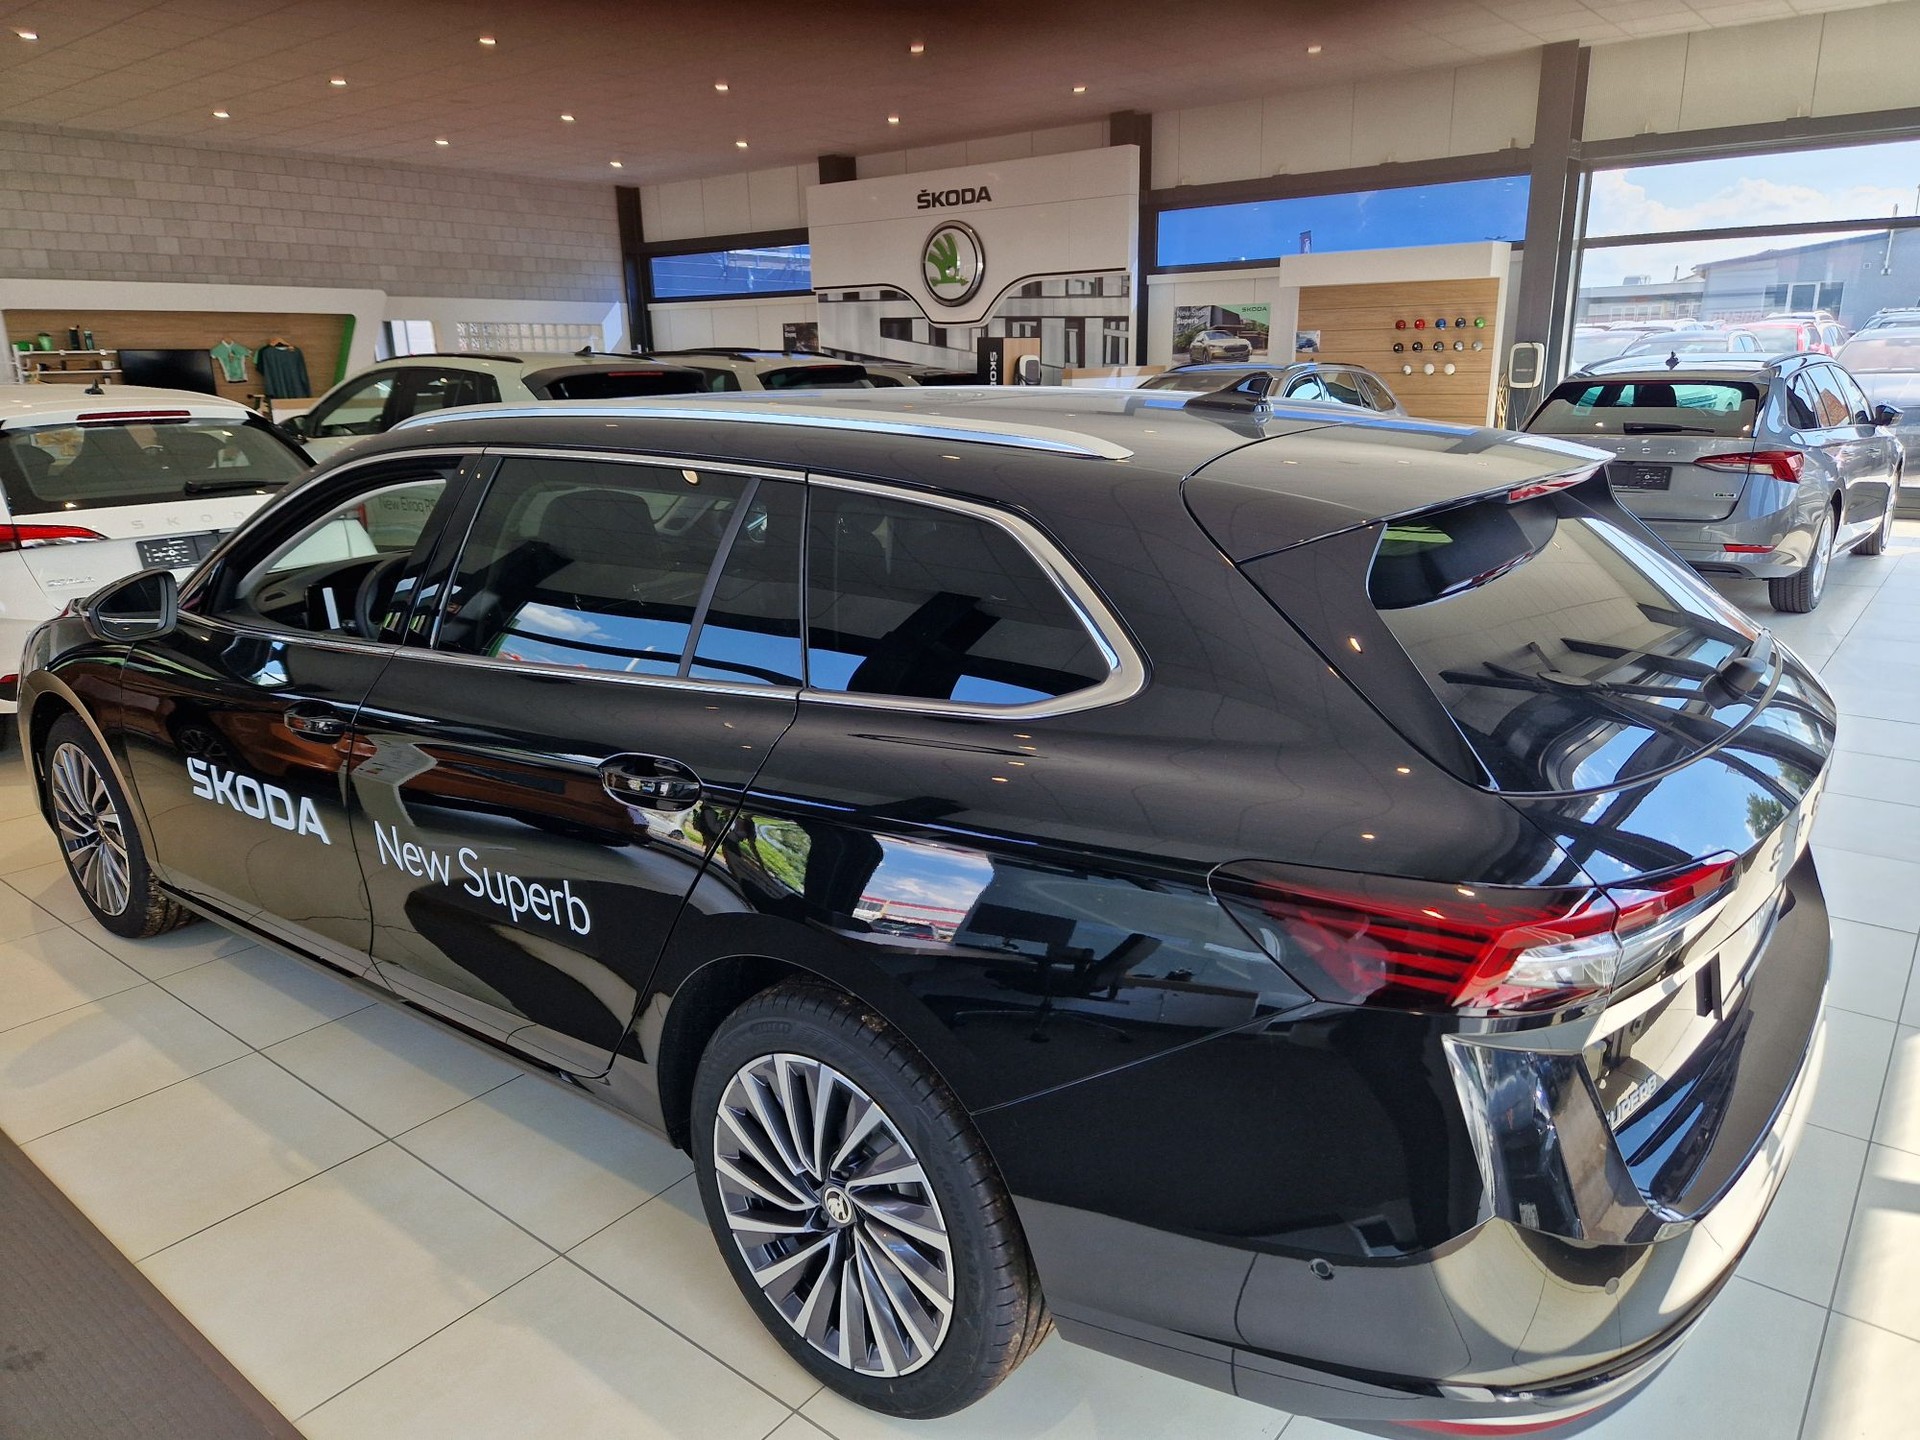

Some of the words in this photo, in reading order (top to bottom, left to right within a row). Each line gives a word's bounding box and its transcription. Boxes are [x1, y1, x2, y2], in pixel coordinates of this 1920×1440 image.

[917, 186, 992, 209] ŠKODA
[1176, 308, 1190, 317] New
[1176, 317, 1199, 325] Superb
[131, 511, 245, 530] SKOD
[373, 820, 451, 887] New
[458, 847, 592, 936] Superb
